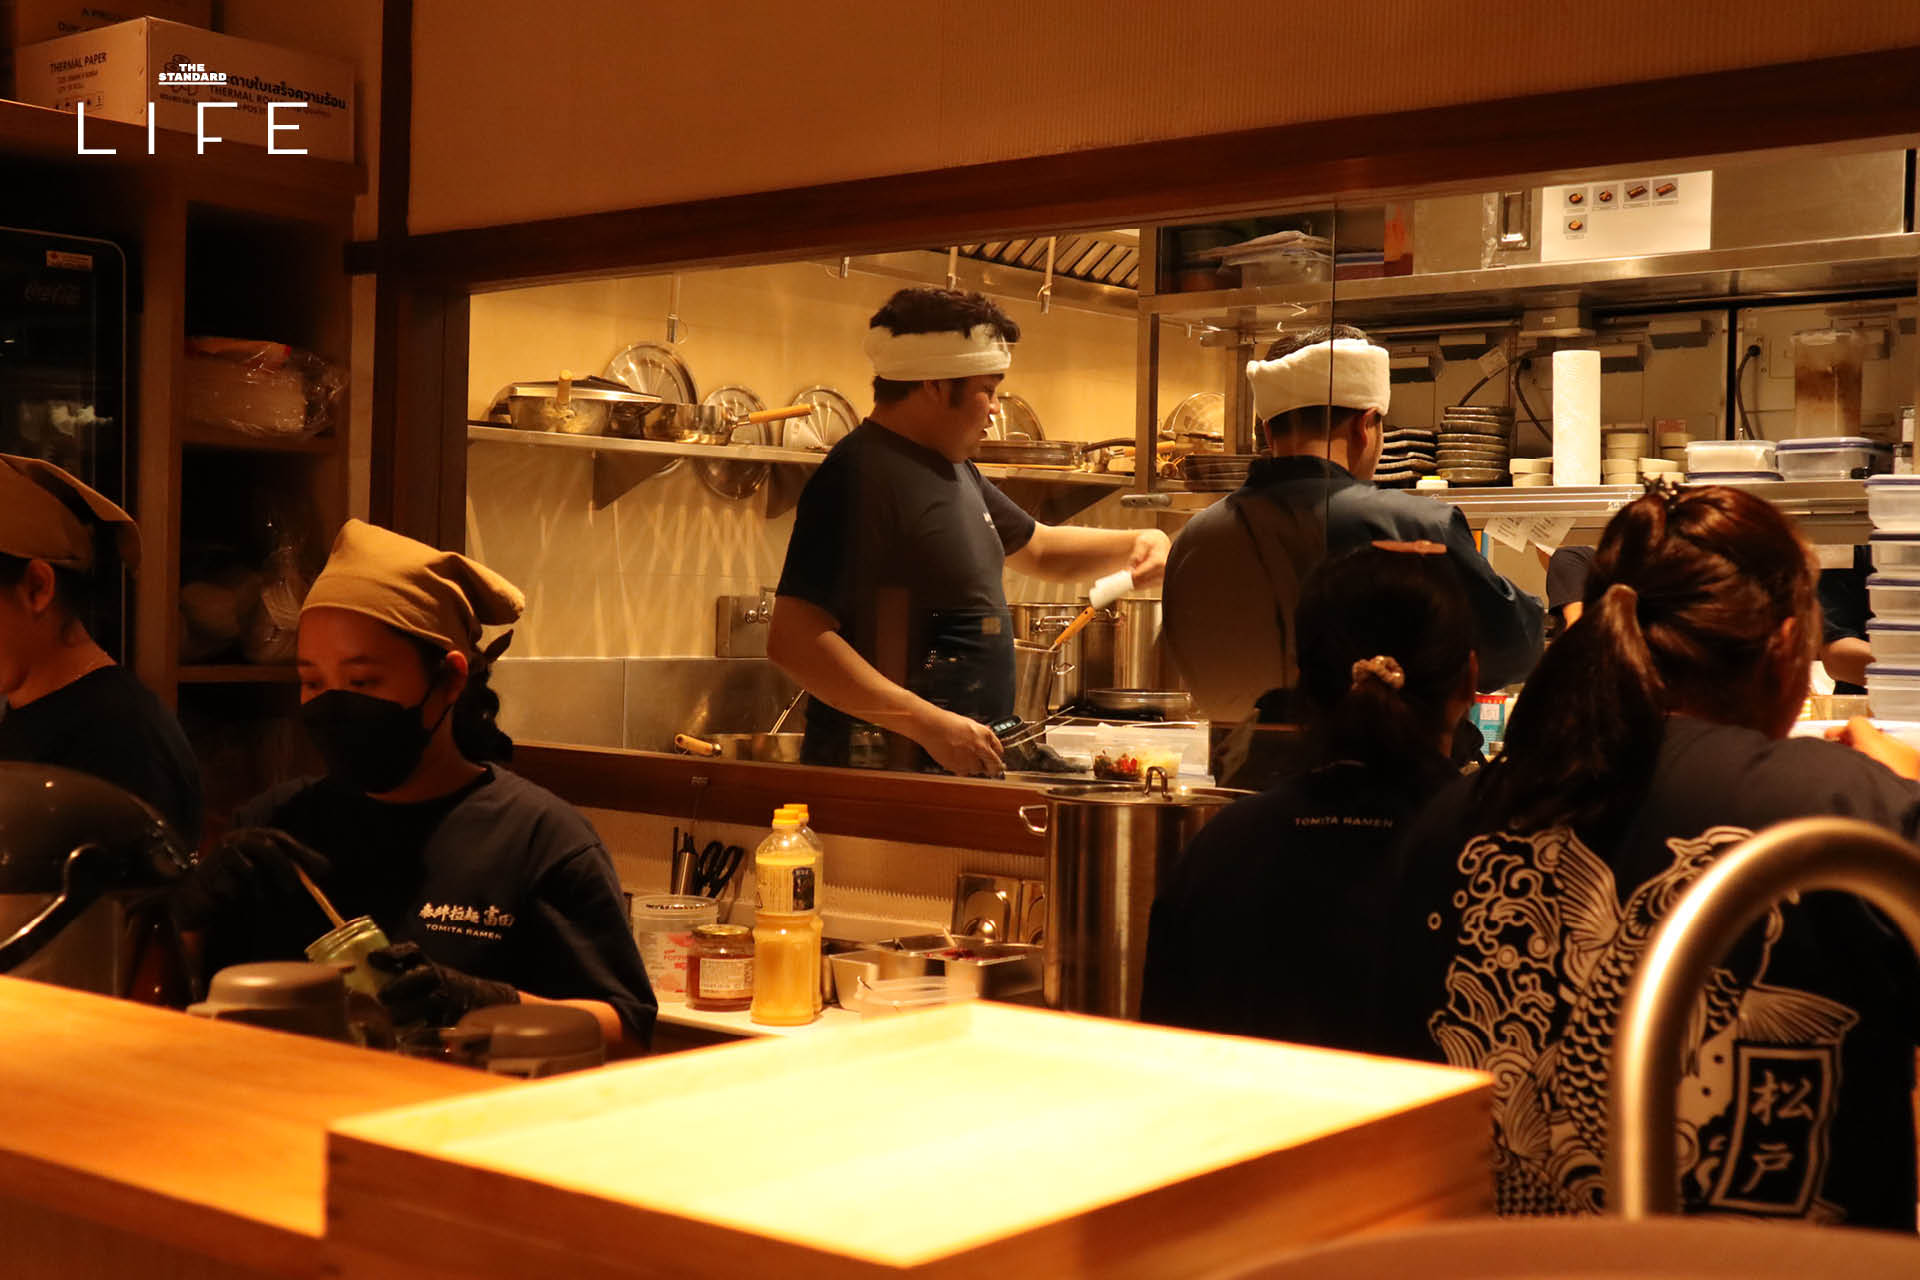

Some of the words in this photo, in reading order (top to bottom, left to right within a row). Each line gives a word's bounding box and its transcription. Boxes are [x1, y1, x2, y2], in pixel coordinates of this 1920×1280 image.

[49, 57, 83, 72] THERMAL
[84, 52, 107, 66] PAPER
[210, 86, 253, 102] THERMAL
[1295, 815, 1339, 825] TOMITA
[1343, 816, 1393, 828] RAMEN
[425, 923, 463, 934] TOMITA
[465, 929, 503, 940] RAMEN
[1740, 1069, 1815, 1194] 松戸
